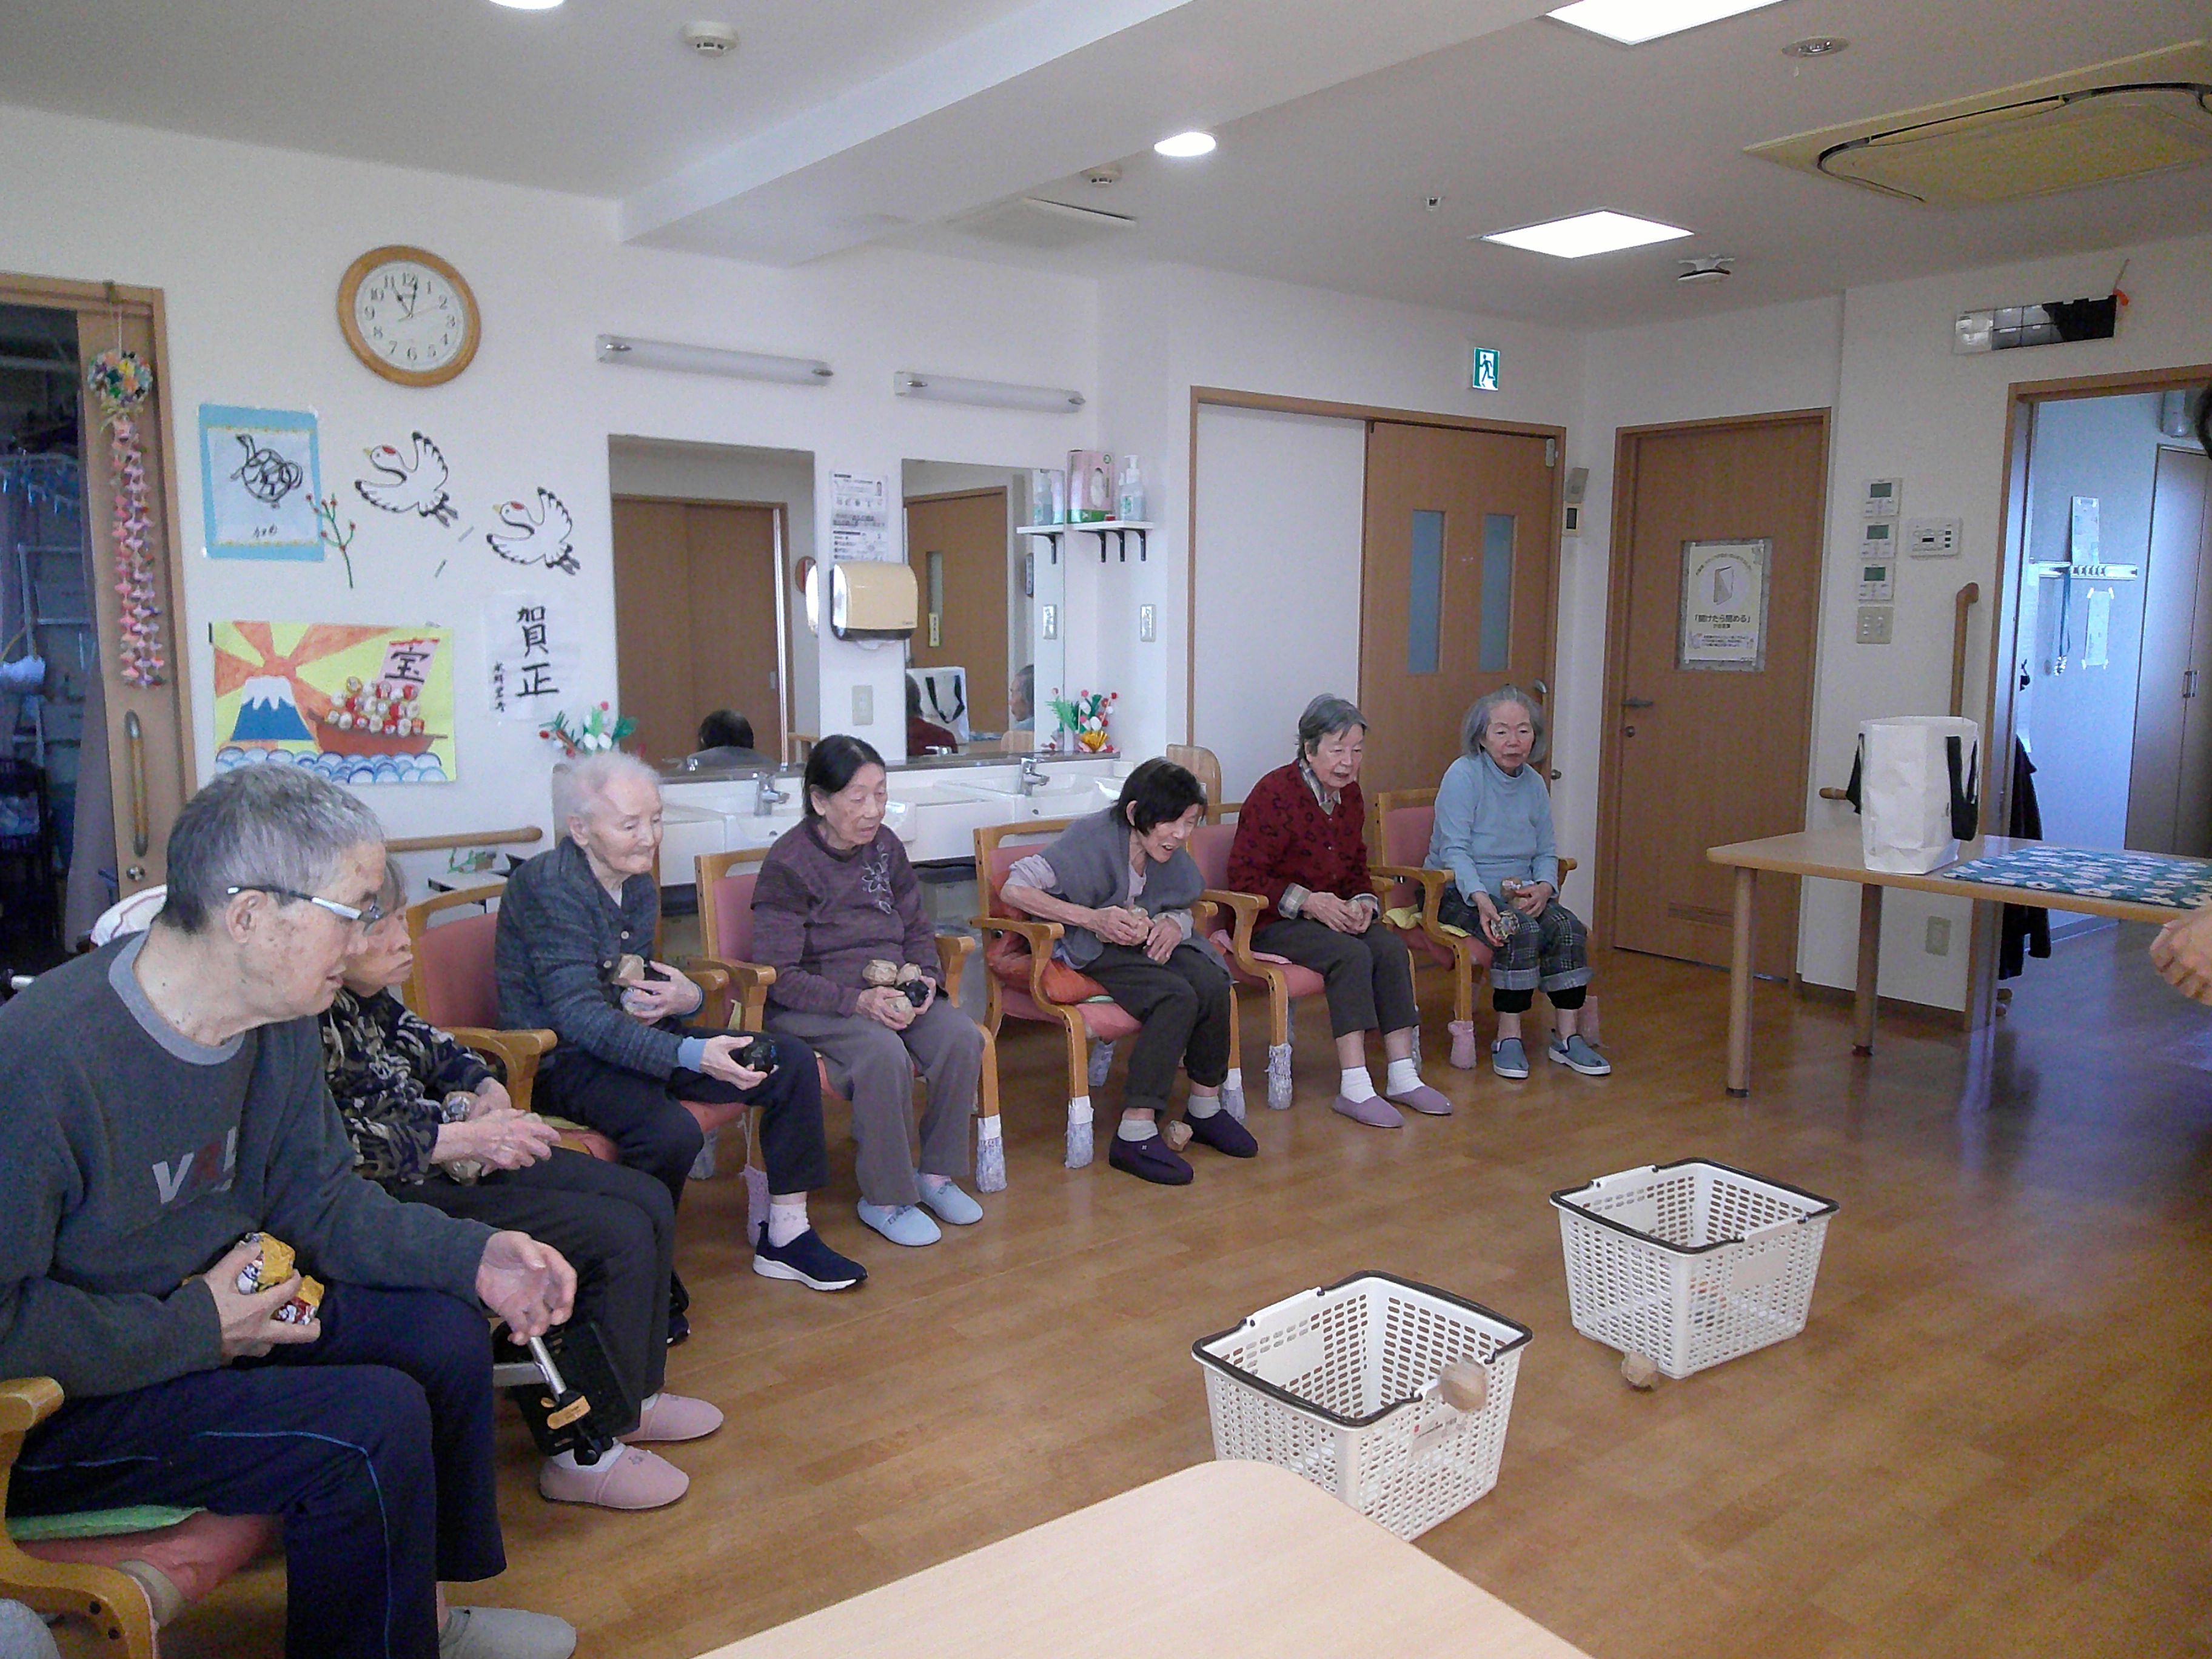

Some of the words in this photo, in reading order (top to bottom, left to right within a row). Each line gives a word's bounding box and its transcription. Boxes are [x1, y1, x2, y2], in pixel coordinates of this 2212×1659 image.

[384, 275, 394, 289] 11
[427, 281, 431, 294] 1
[371, 287, 384, 301] 10
[438, 295, 447, 310] 2
[364, 304, 375, 321] 9
[446, 315, 455, 329] 3
[373, 324, 383, 340] 8
[440, 333, 447, 346] 4
[389, 340, 397, 354] 7
[407, 347, 417, 360] 6
[427, 344, 436, 358] 5
[385, 646, 429, 683] 宝
